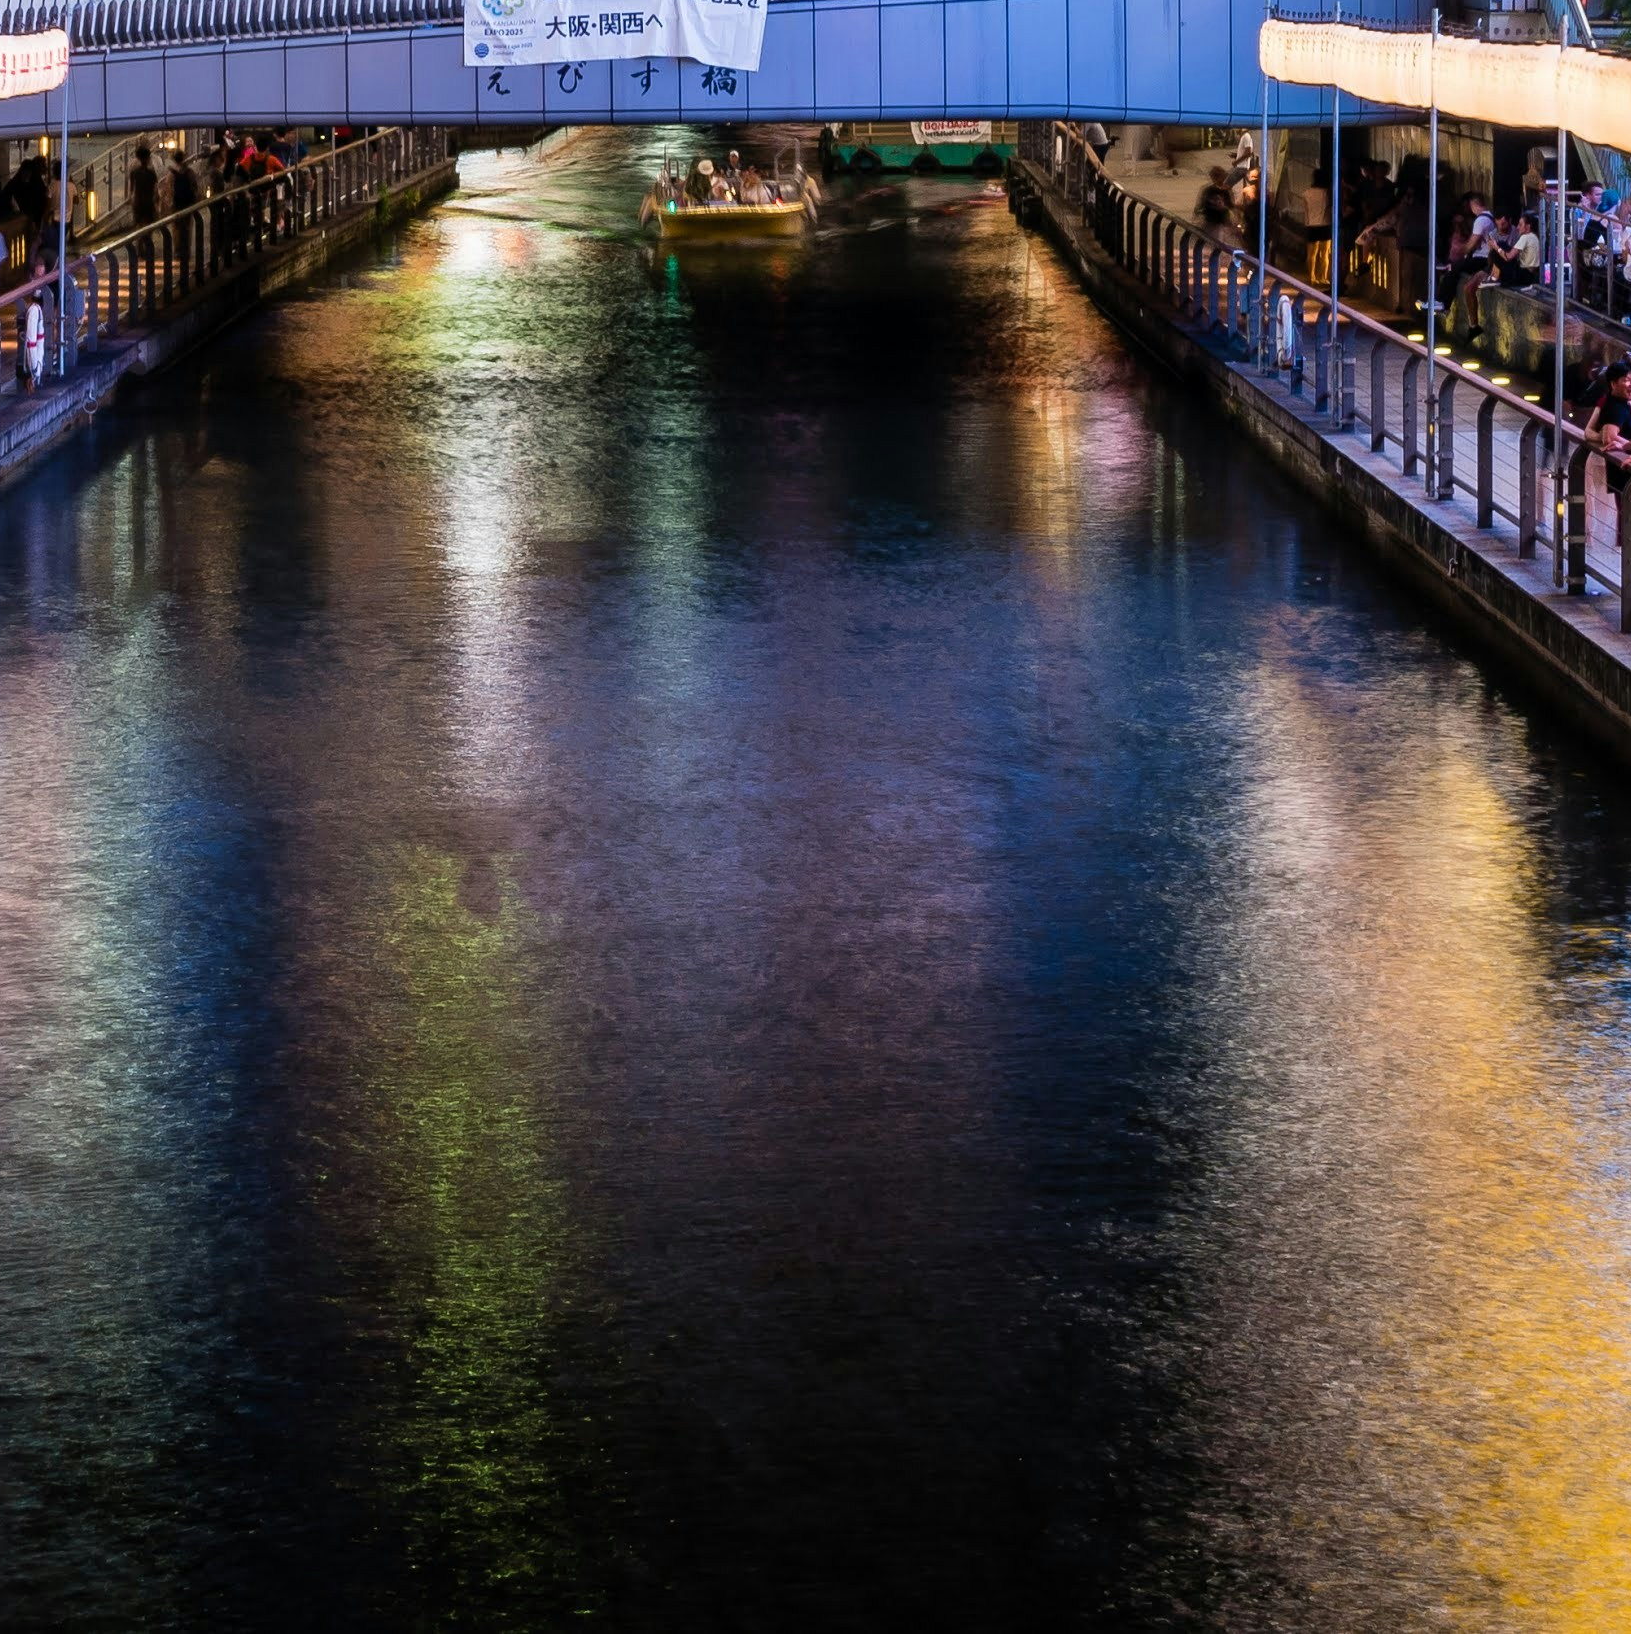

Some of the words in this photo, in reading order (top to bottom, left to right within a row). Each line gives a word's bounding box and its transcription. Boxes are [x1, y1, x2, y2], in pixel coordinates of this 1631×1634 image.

[545, 12, 664, 41] 大阪・関西へ
